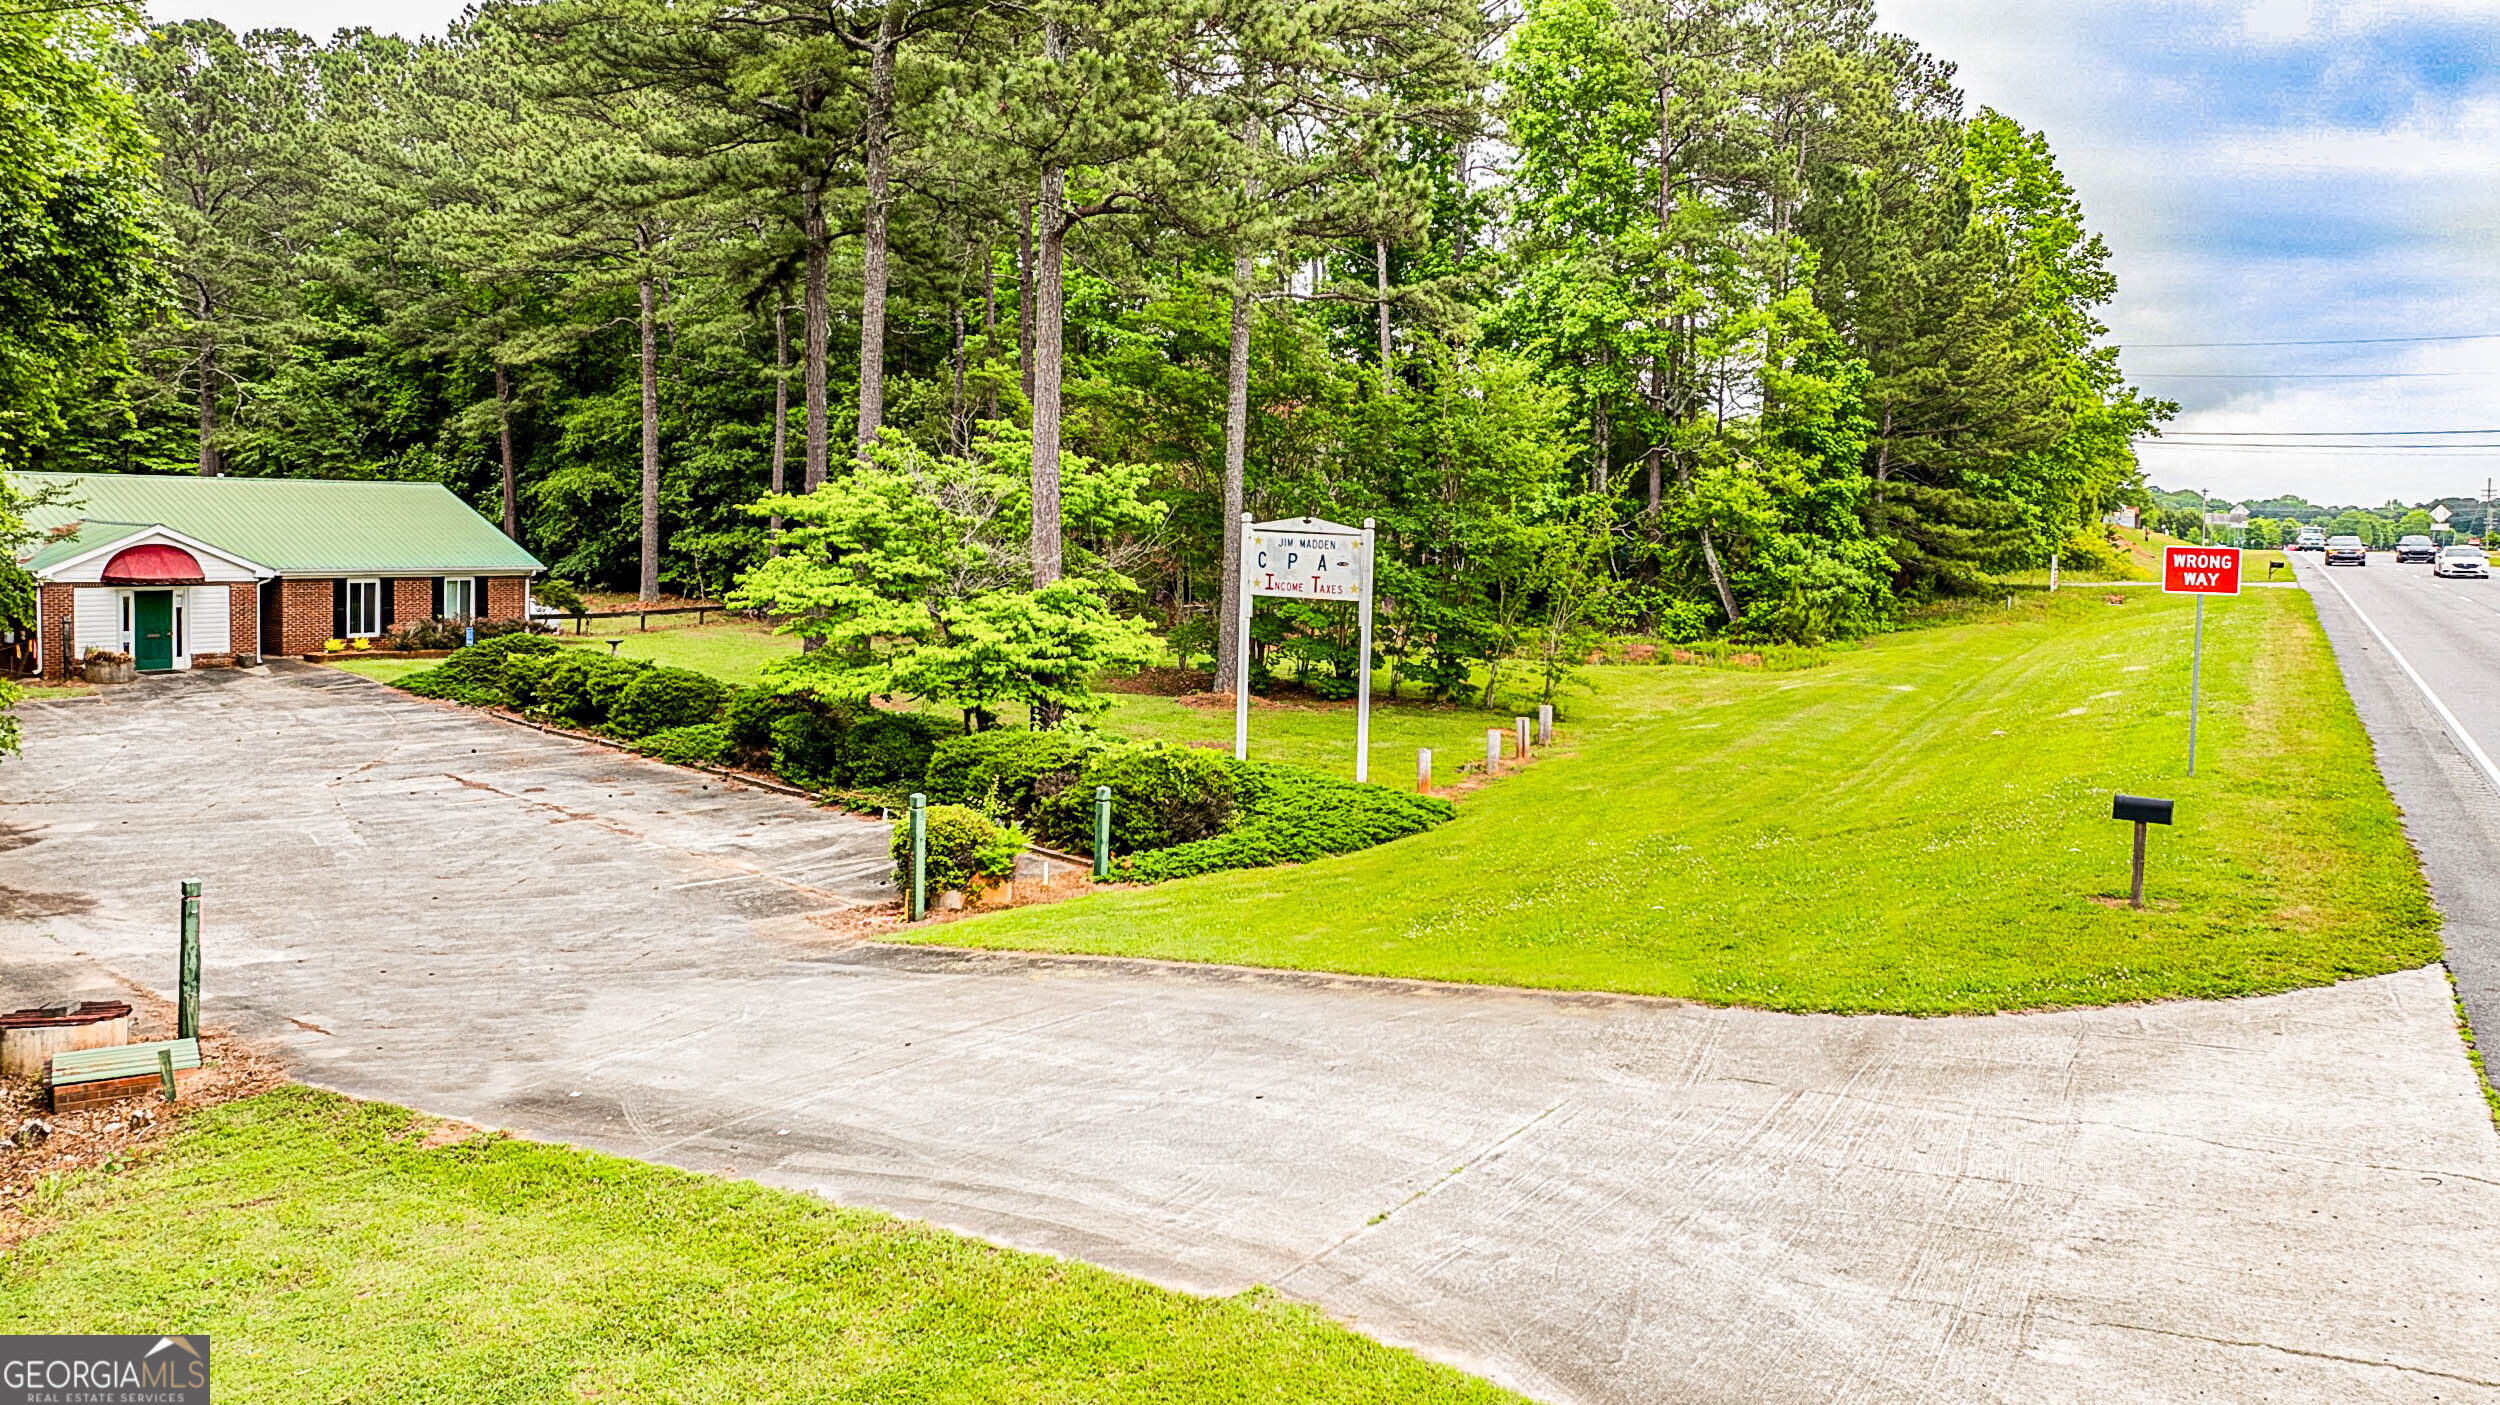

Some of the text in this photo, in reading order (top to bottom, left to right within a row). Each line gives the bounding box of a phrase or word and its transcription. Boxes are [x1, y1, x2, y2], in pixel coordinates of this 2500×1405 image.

[1278, 538, 1336, 550] JIM MADDEN
[2173, 554, 2232, 569] WRONG
[2184, 572, 2219, 586] WAY
